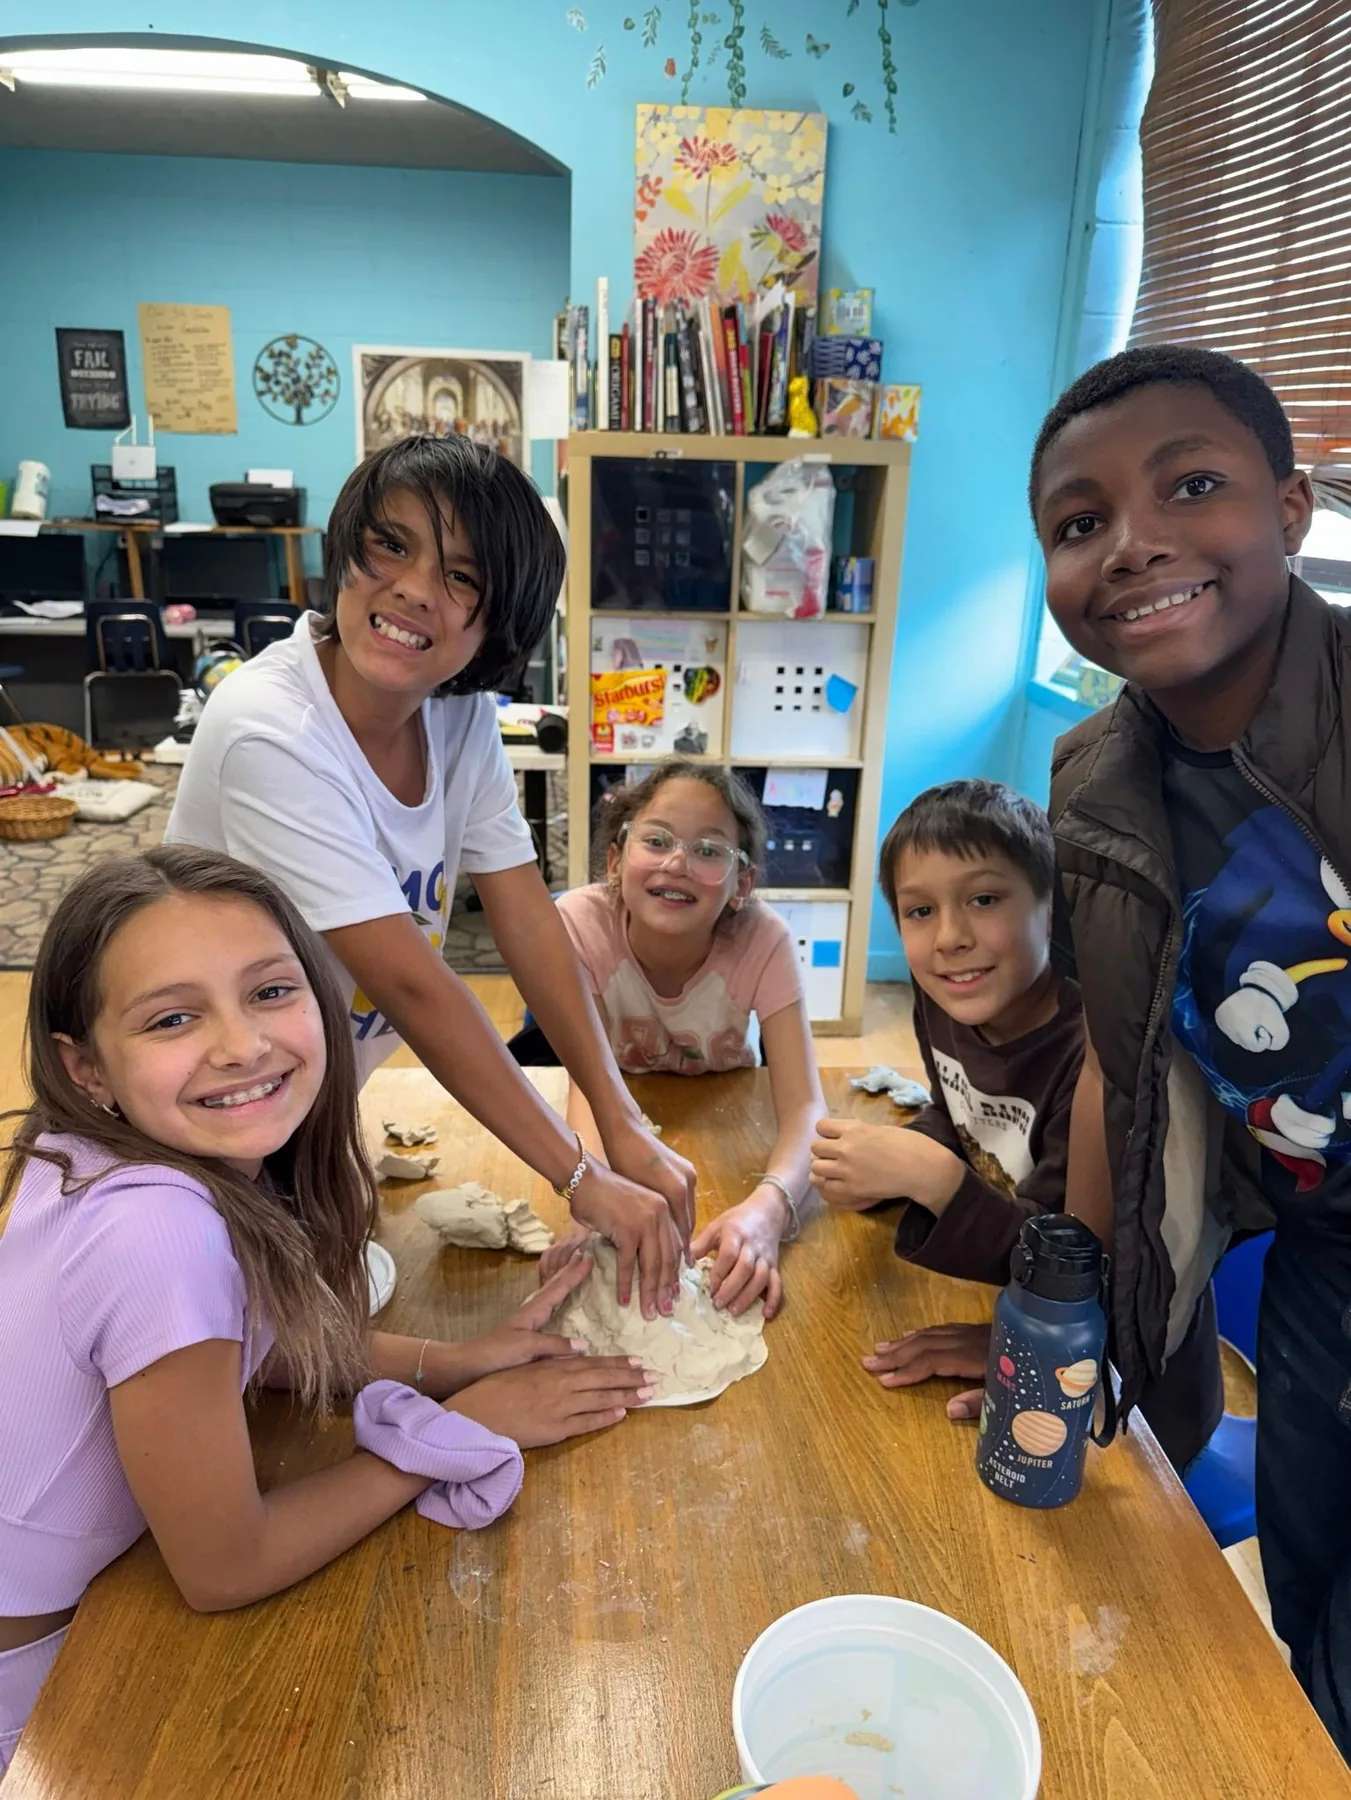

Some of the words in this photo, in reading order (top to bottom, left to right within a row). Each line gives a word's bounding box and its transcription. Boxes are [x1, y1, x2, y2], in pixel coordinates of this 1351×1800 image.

[73, 349, 110, 369] FAIL
[611, 365, 621, 421] ORIGAMI
[996, 1371, 1017, 1393] MARS
[1060, 1394, 1092, 1411] SATURN
[988, 1456, 1027, 1484] ASTEROID
[1016, 1454, 1054, 1470] JUPITER
[994, 1471, 1015, 1489] BELT
